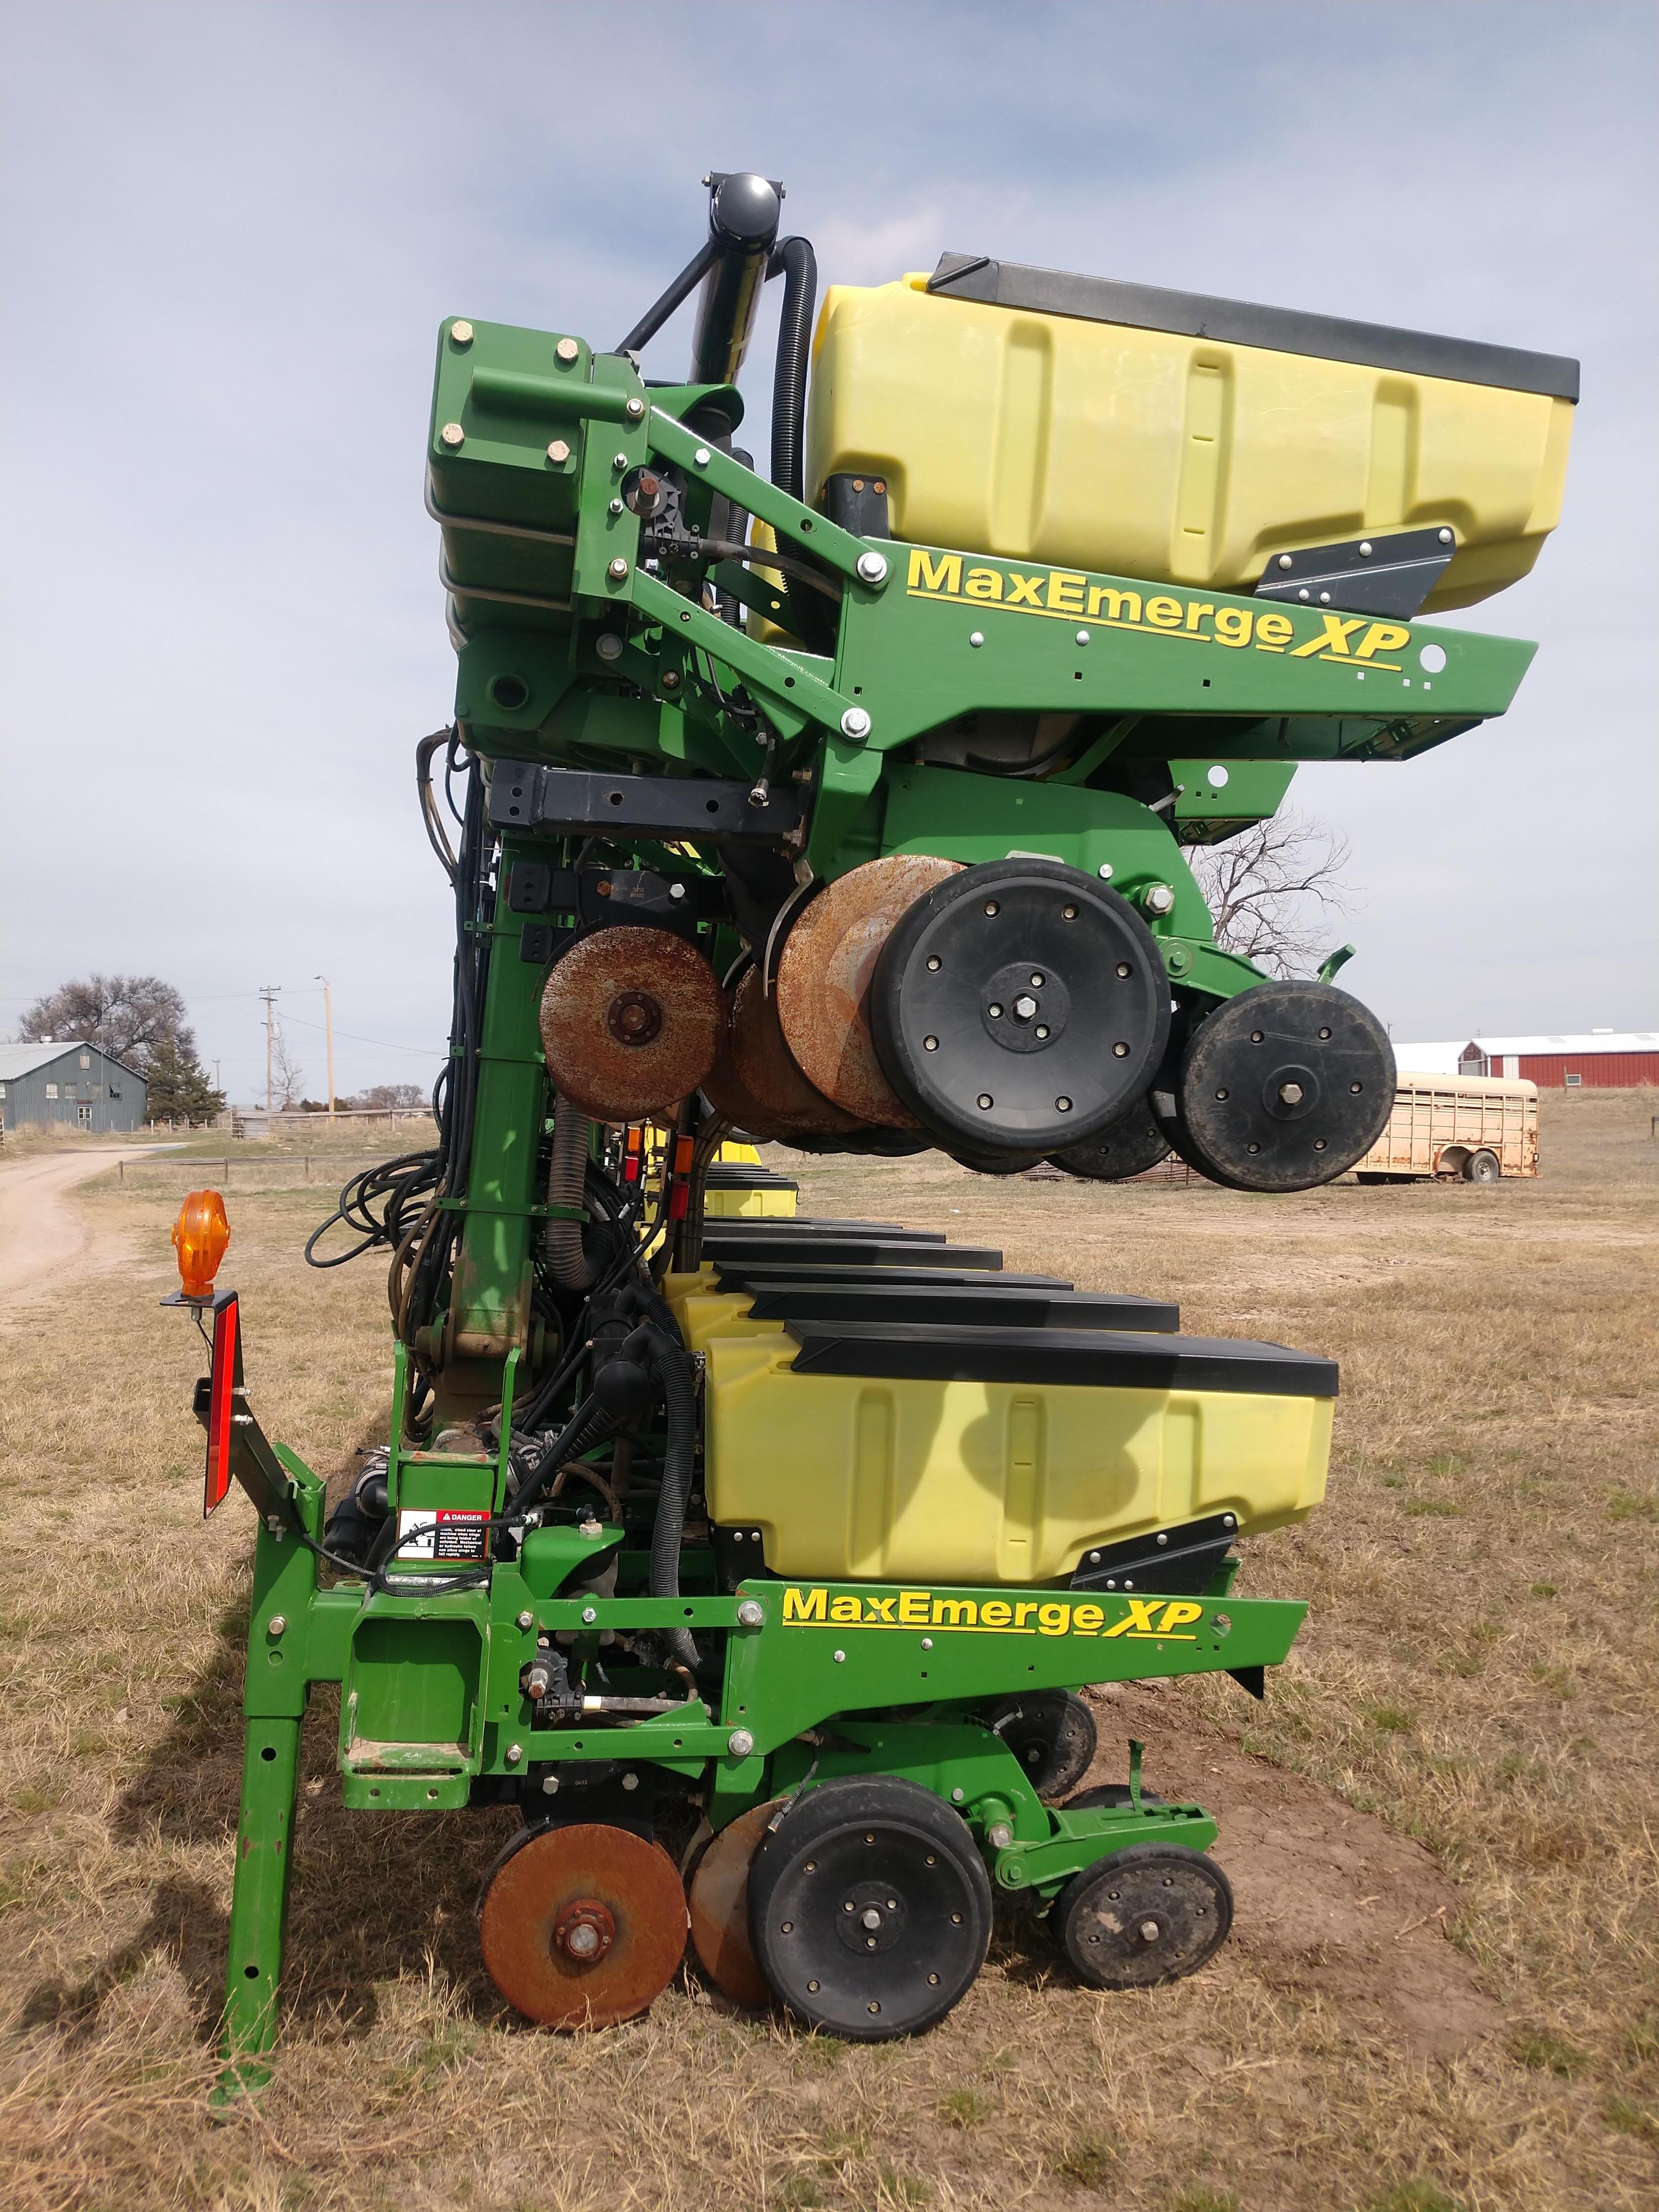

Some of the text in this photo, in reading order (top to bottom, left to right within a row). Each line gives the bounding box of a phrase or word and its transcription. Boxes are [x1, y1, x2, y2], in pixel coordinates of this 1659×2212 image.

[907, 550, 1410, 659] MaxEmerge XP
[783, 1588, 1202, 1637] MaxEmerge XP
